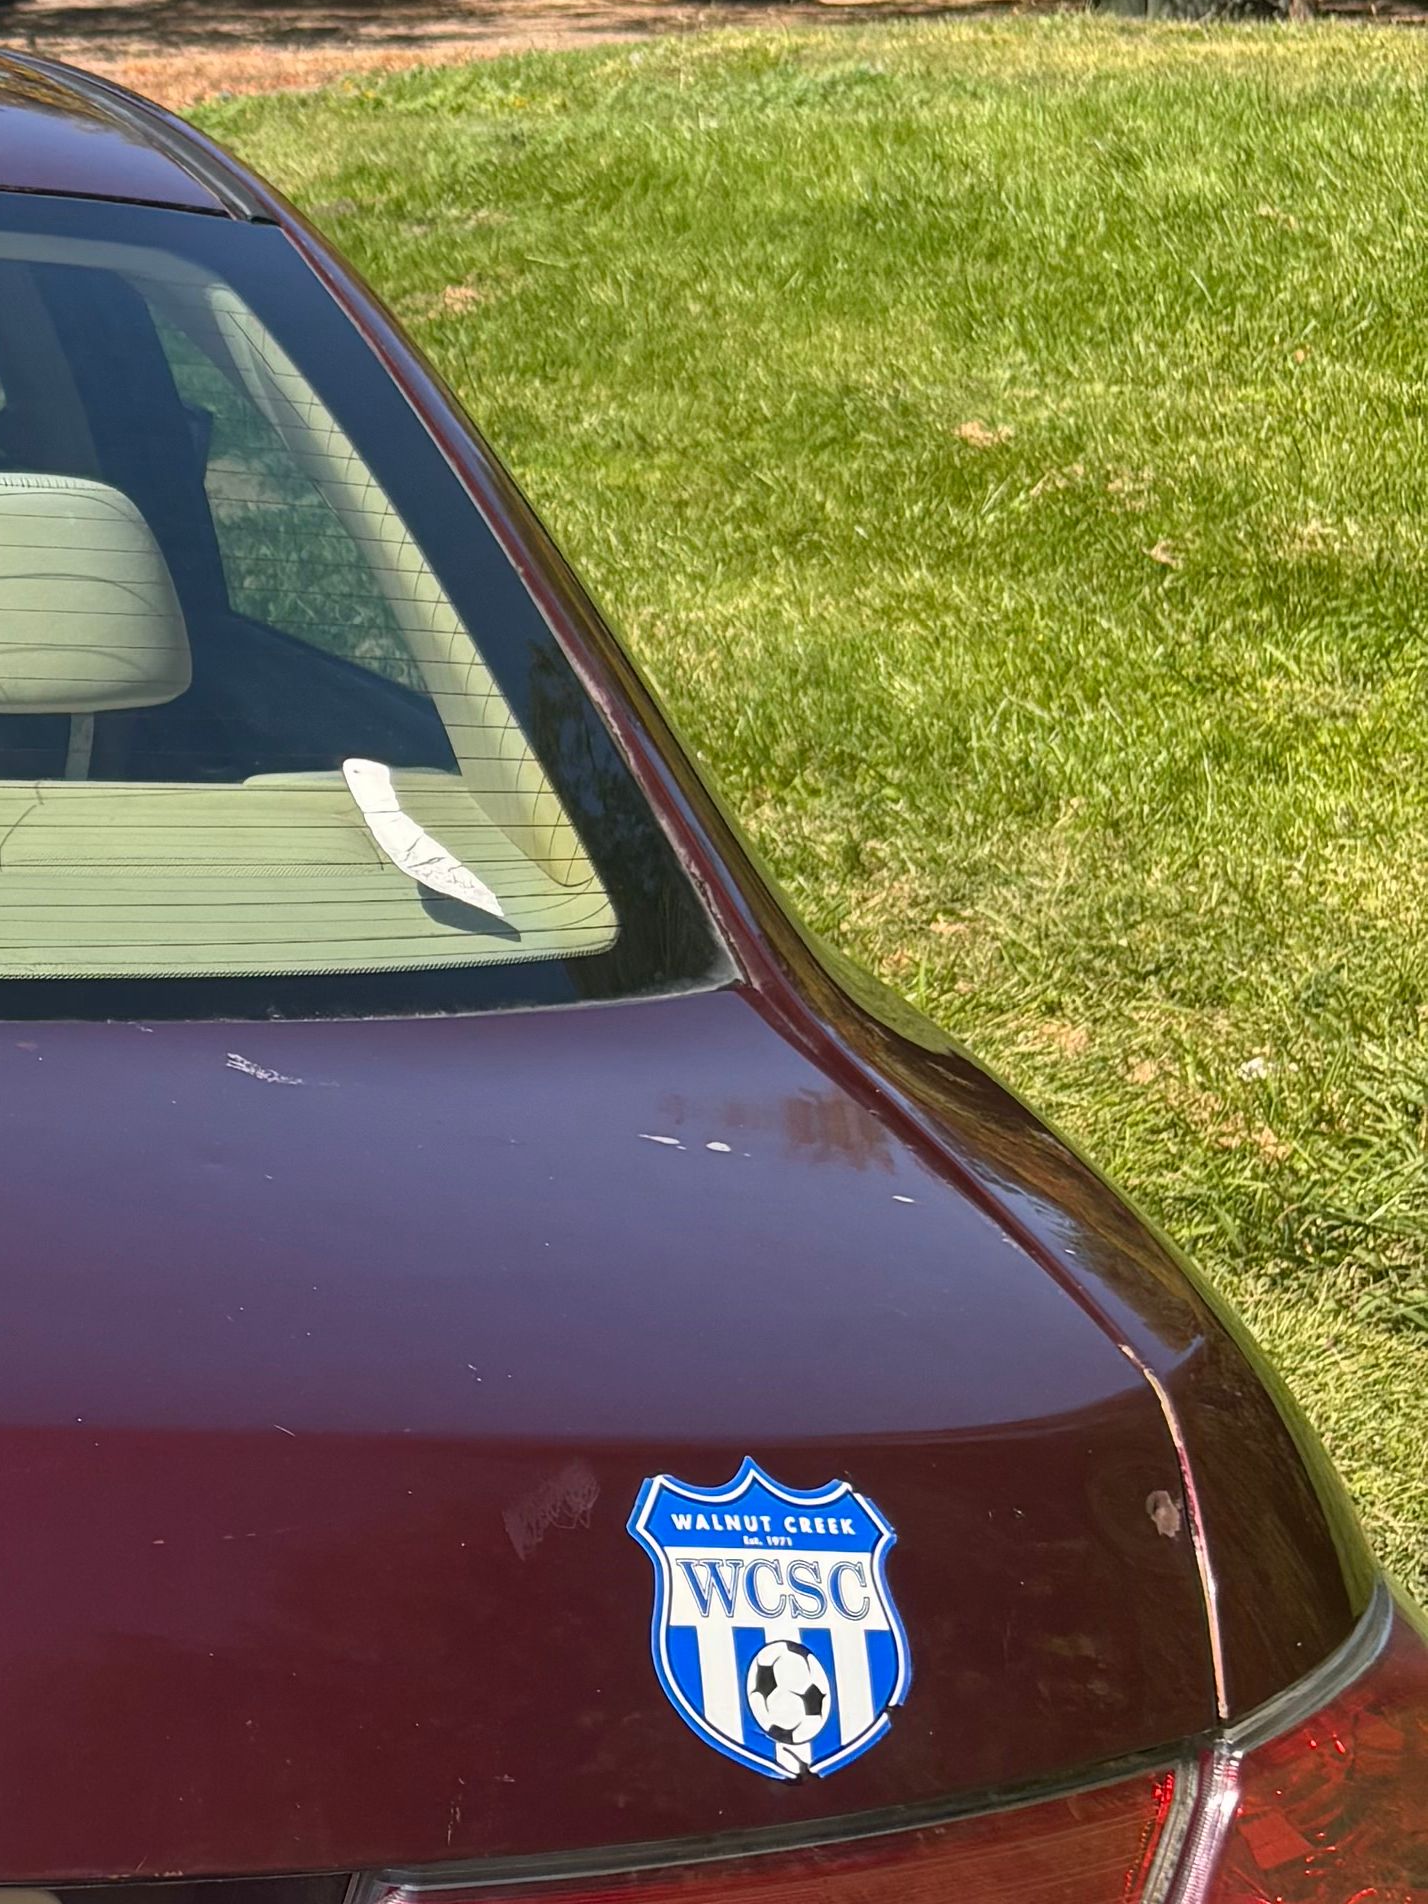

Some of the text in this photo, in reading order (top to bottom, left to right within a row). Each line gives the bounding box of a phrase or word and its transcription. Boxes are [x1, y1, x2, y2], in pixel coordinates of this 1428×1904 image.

[670, 1513, 857, 1536] WALNUT CREEK
[766, 1535, 793, 1547] 1971
[675, 1558, 871, 1621] WCSC
